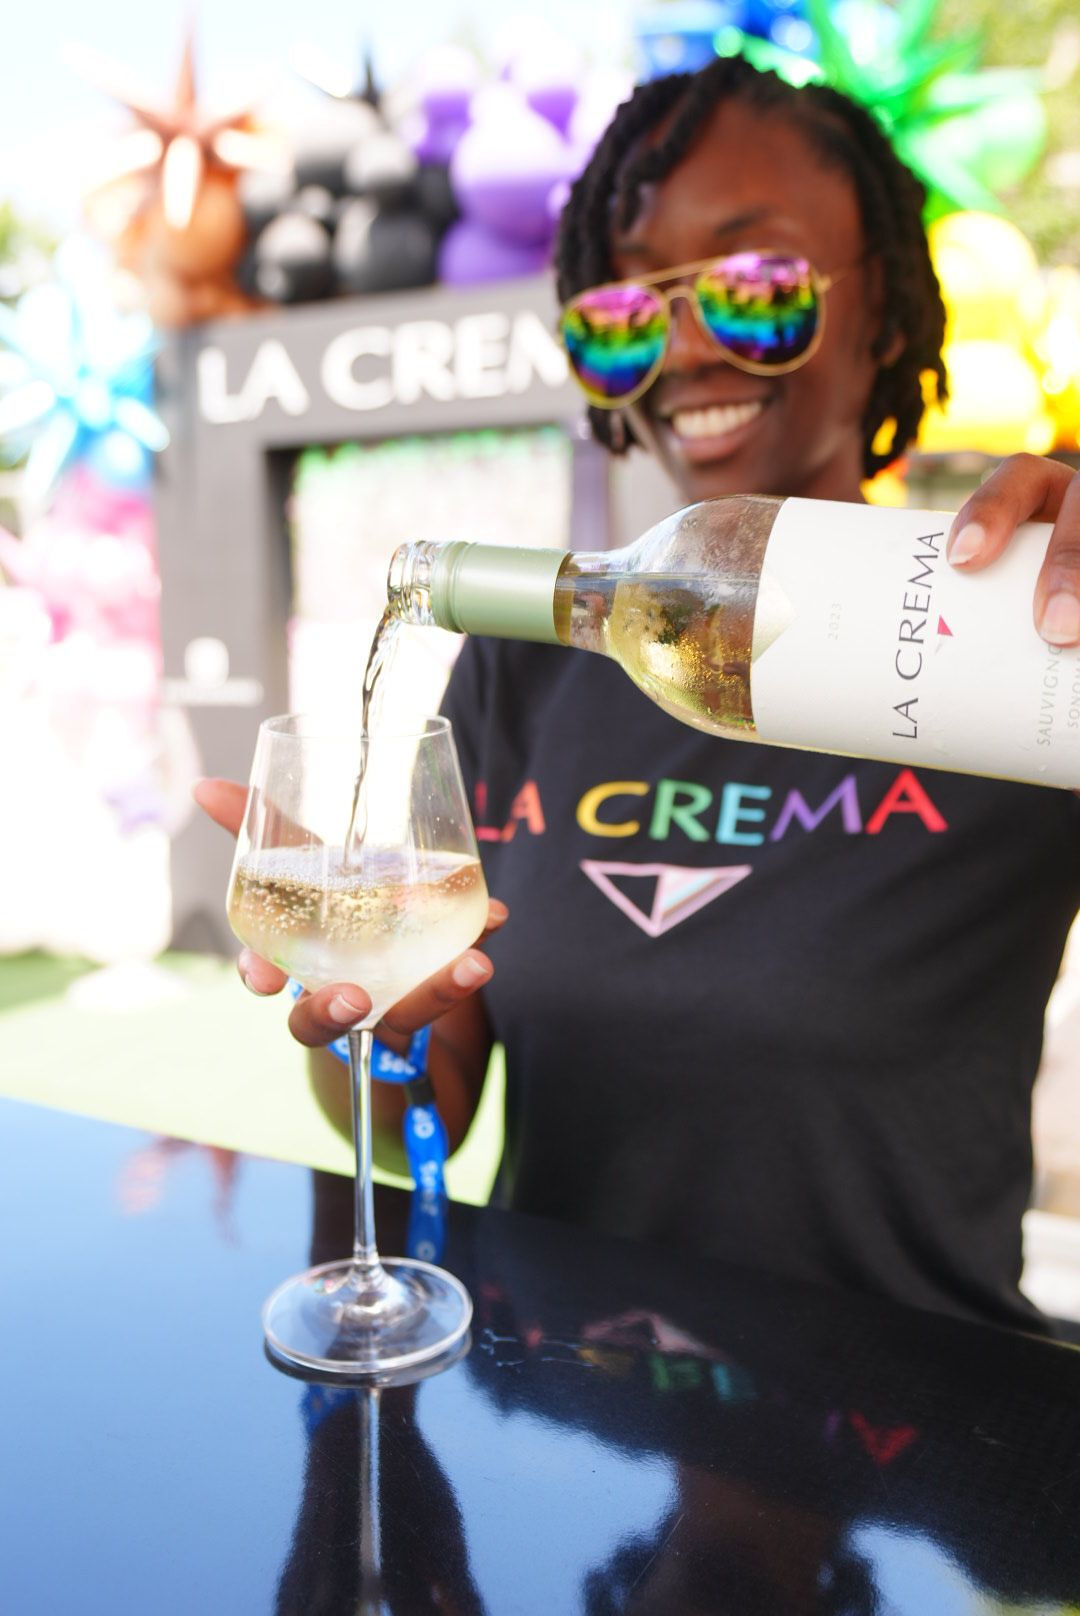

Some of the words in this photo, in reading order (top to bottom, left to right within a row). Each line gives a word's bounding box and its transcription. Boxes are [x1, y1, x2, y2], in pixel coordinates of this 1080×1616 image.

[198, 339, 309, 424] LA
[321, 311, 569, 411] CREM
[896, 532, 944, 680] CREMA
[892, 698, 918, 739] LA
[1037, 643, 1062, 746] SAUVIGNO
[475, 779, 546, 842] LA
[576, 769, 949, 846] CREMA
